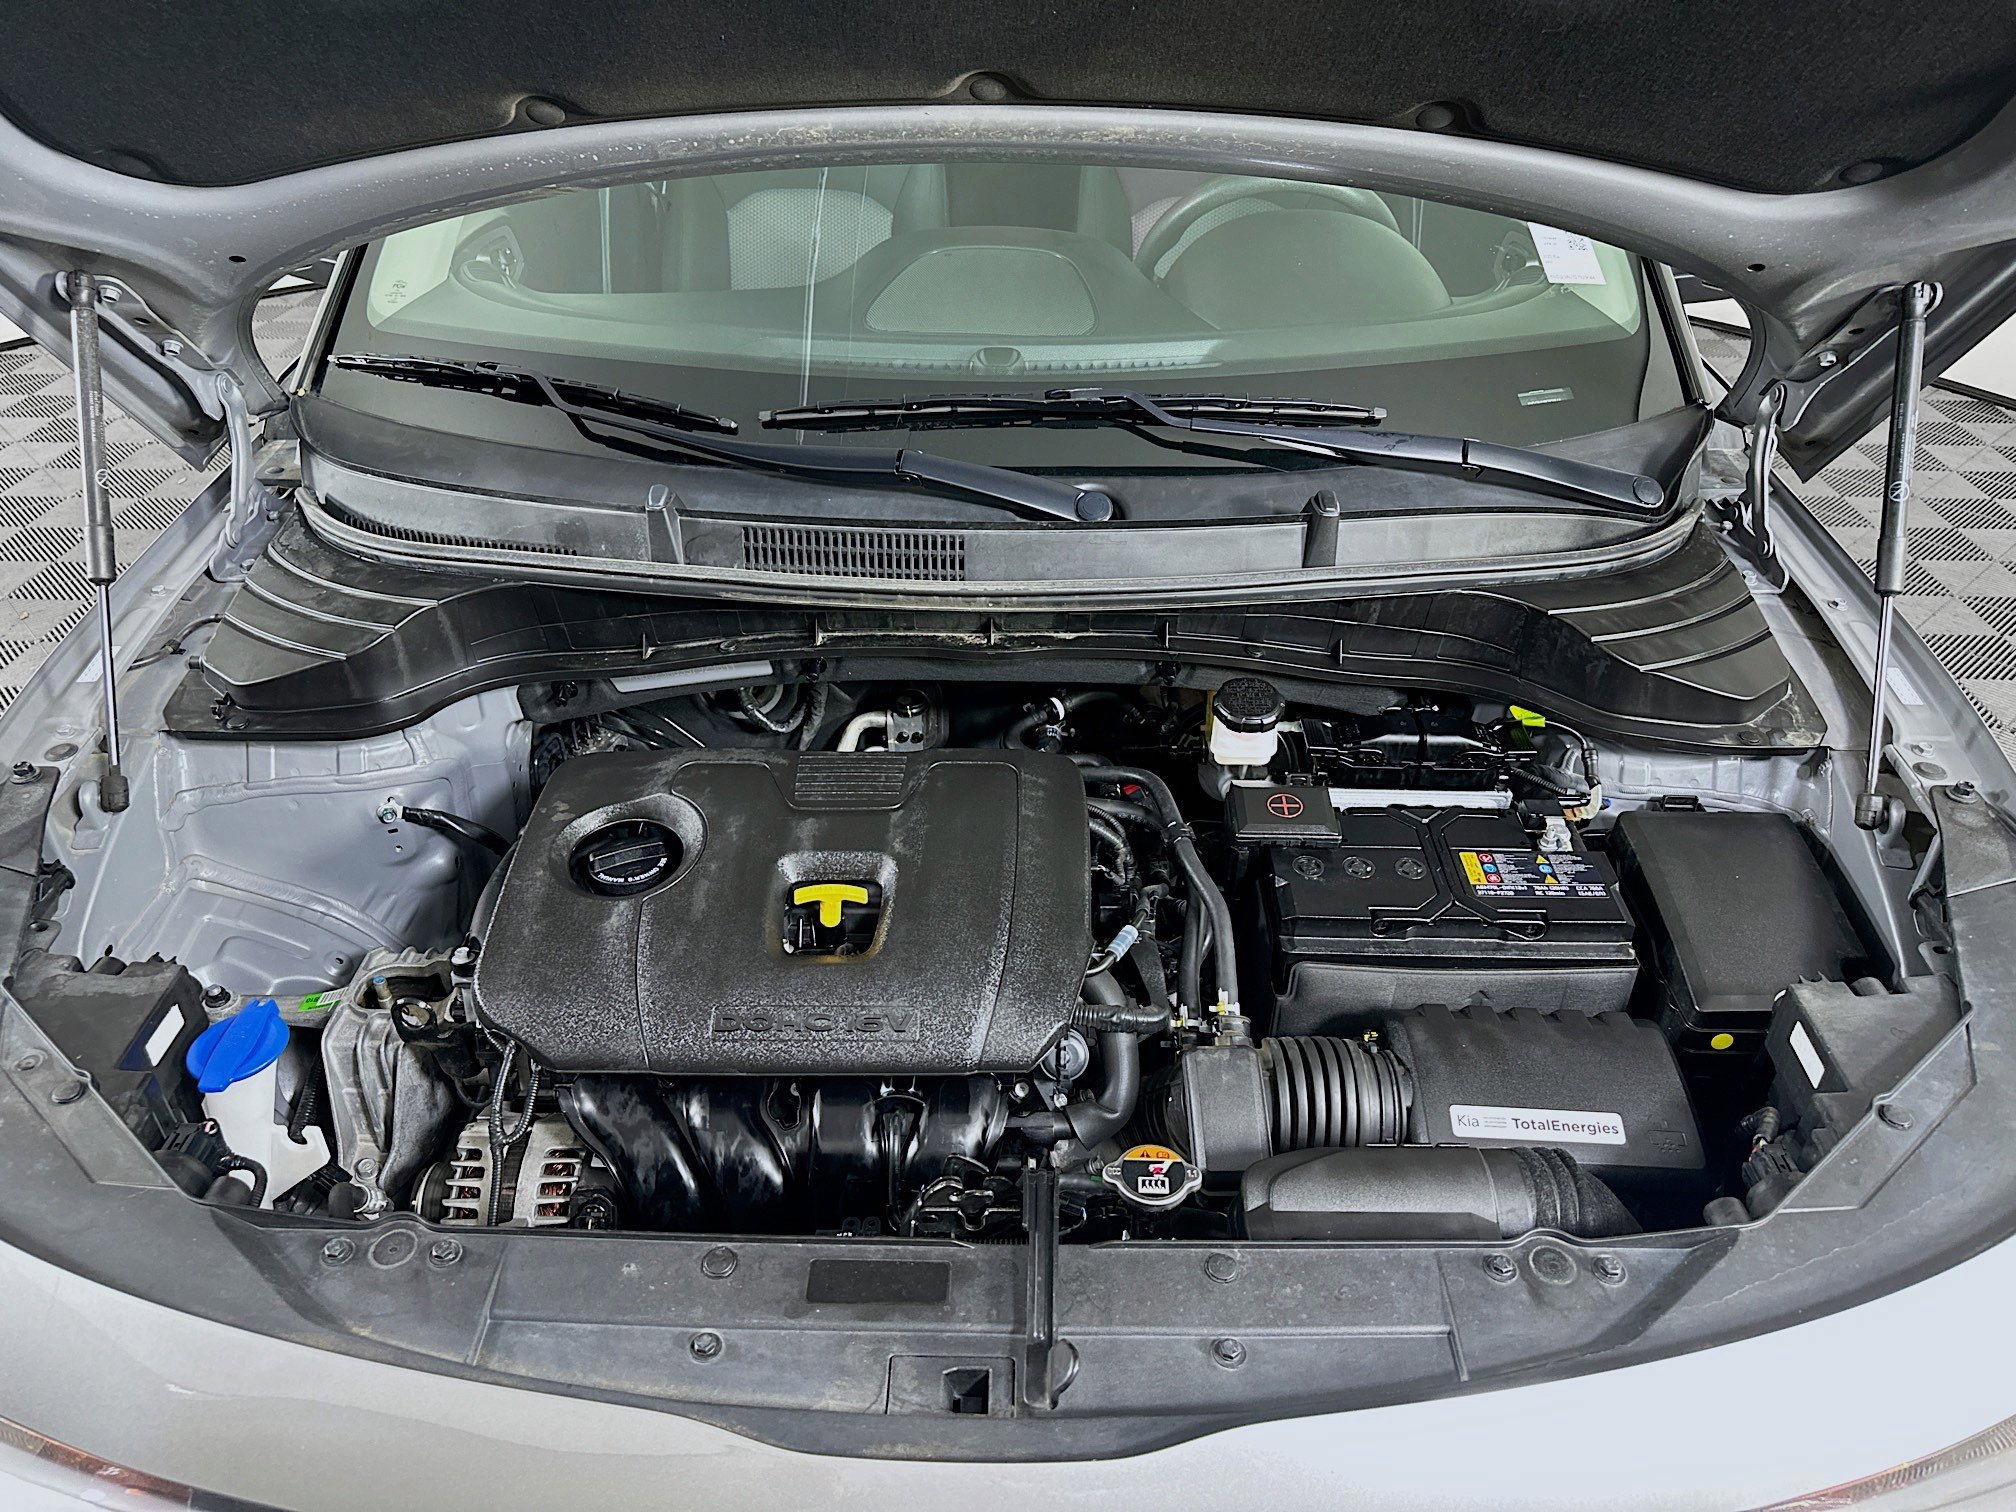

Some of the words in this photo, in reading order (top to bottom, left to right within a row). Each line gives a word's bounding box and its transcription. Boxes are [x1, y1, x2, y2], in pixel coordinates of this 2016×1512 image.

[656, 857, 668, 868] SEE
[597, 872, 625, 883] MANUAL
[627, 866, 660, 882] OWNER'S
[713, 1014, 833, 1032] DOHC
[846, 1014, 914, 1032] 16V
[1456, 1114, 1480, 1128] Kia
[1511, 1117, 1619, 1136] TotalEnergies
[1187, 1169, 1198, 1178] 1.1
